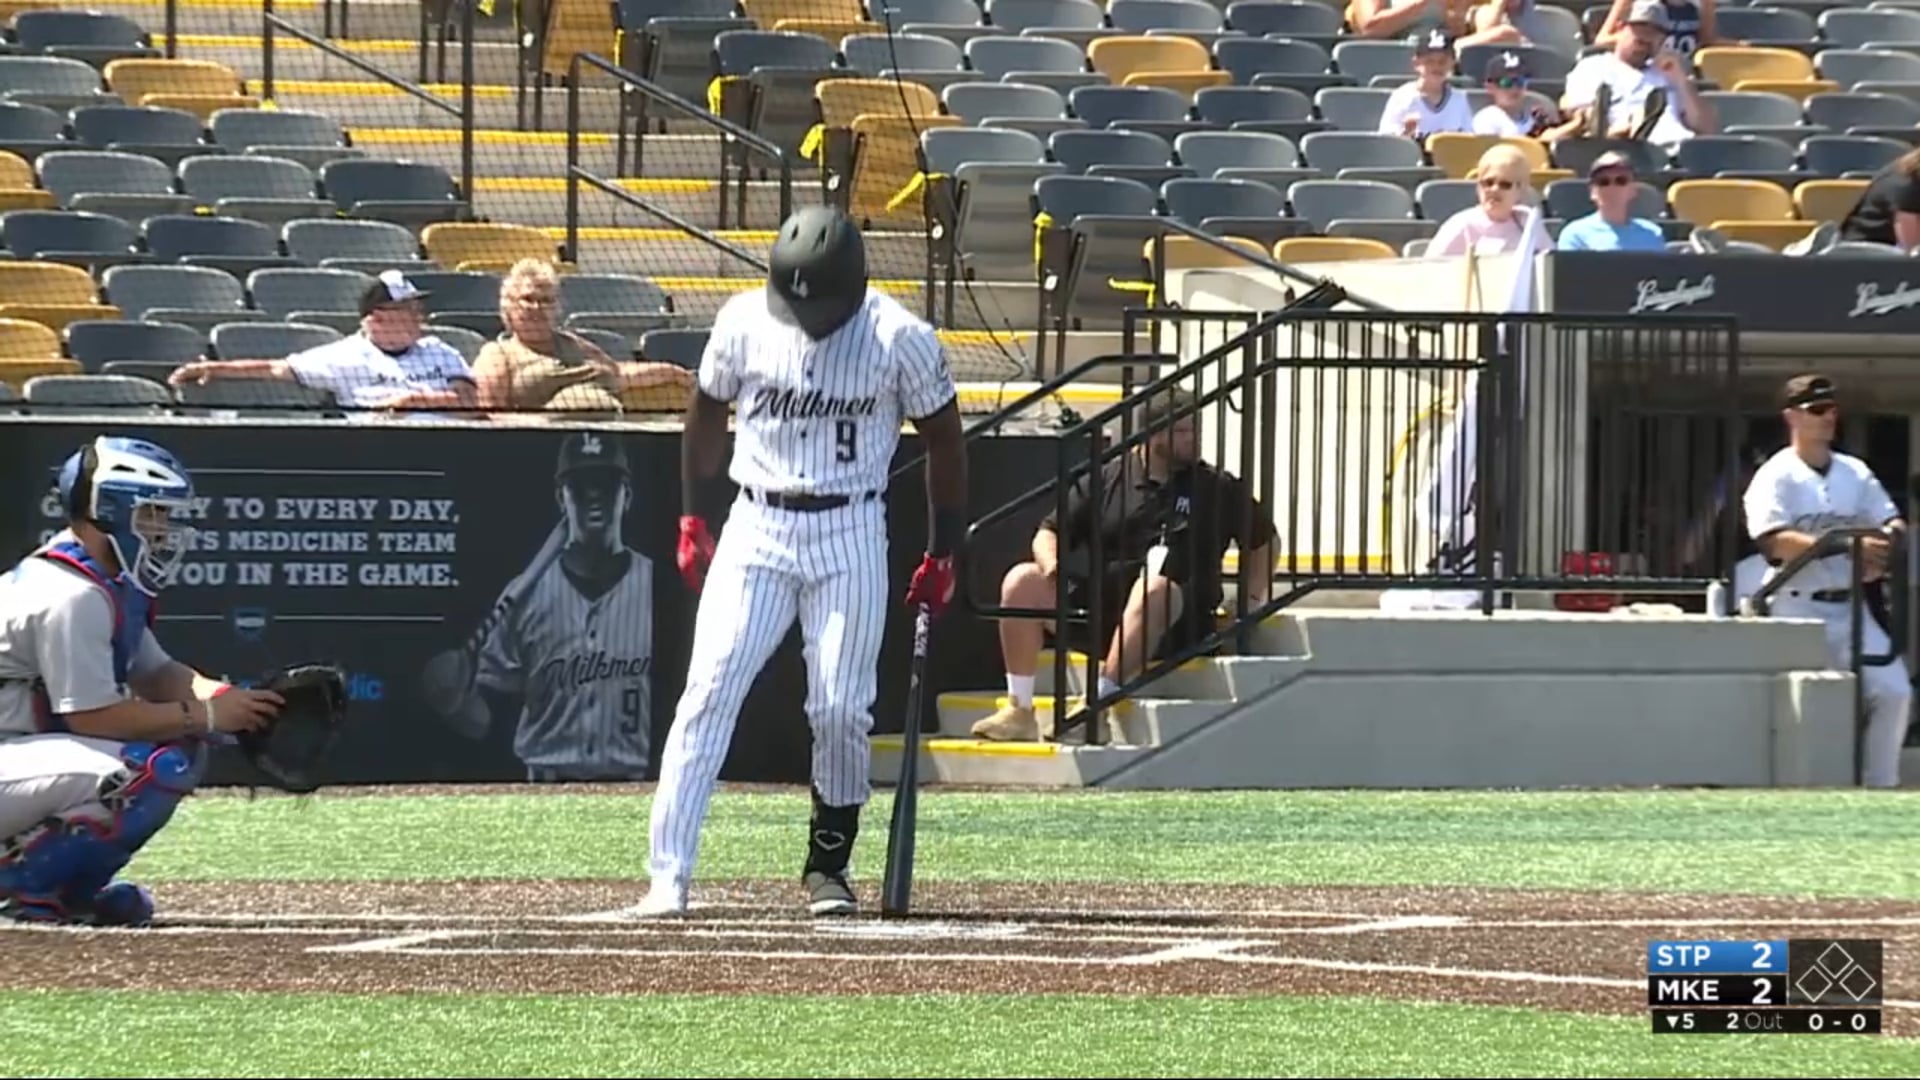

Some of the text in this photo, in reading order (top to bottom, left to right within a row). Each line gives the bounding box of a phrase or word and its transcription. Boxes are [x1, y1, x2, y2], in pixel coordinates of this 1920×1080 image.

[746, 387, 876, 422] Milkmen
[836, 420, 857, 462] 9
[224, 497, 265, 519] TO
[276, 498, 378, 520] EVERY
[389, 499, 460, 523] DAY,
[228, 531, 369, 552] MEDICINE
[378, 532, 456, 553] TEAM
[165, 562, 459, 586] YOU IN THE GAME.
[622, 689, 640, 734] 9
